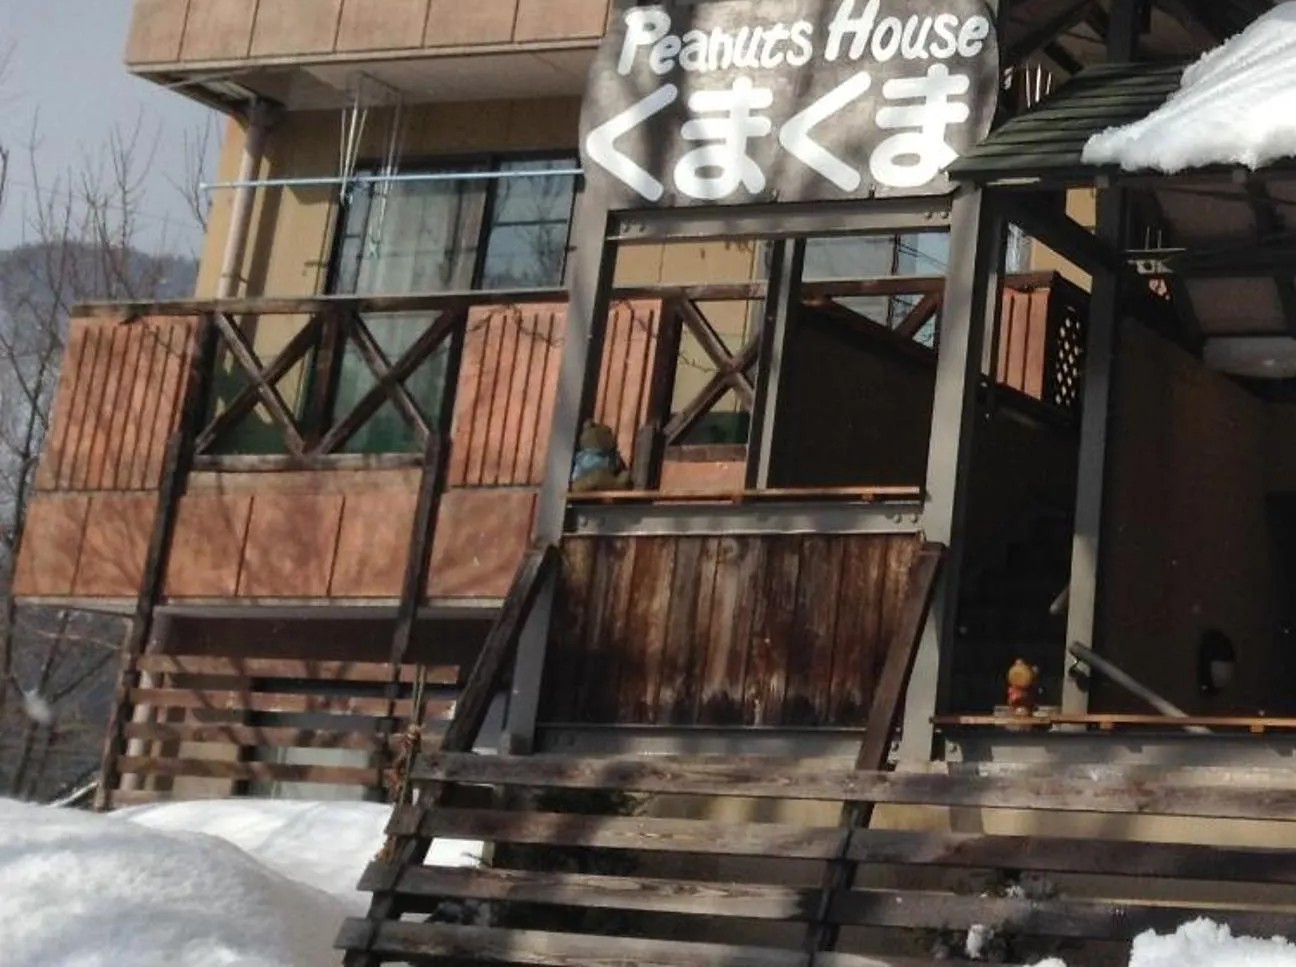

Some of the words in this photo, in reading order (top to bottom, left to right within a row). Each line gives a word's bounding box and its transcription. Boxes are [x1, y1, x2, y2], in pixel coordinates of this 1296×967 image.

[618, 5, 813, 76] Peanuts
[586, 63, 970, 202] くまくま
